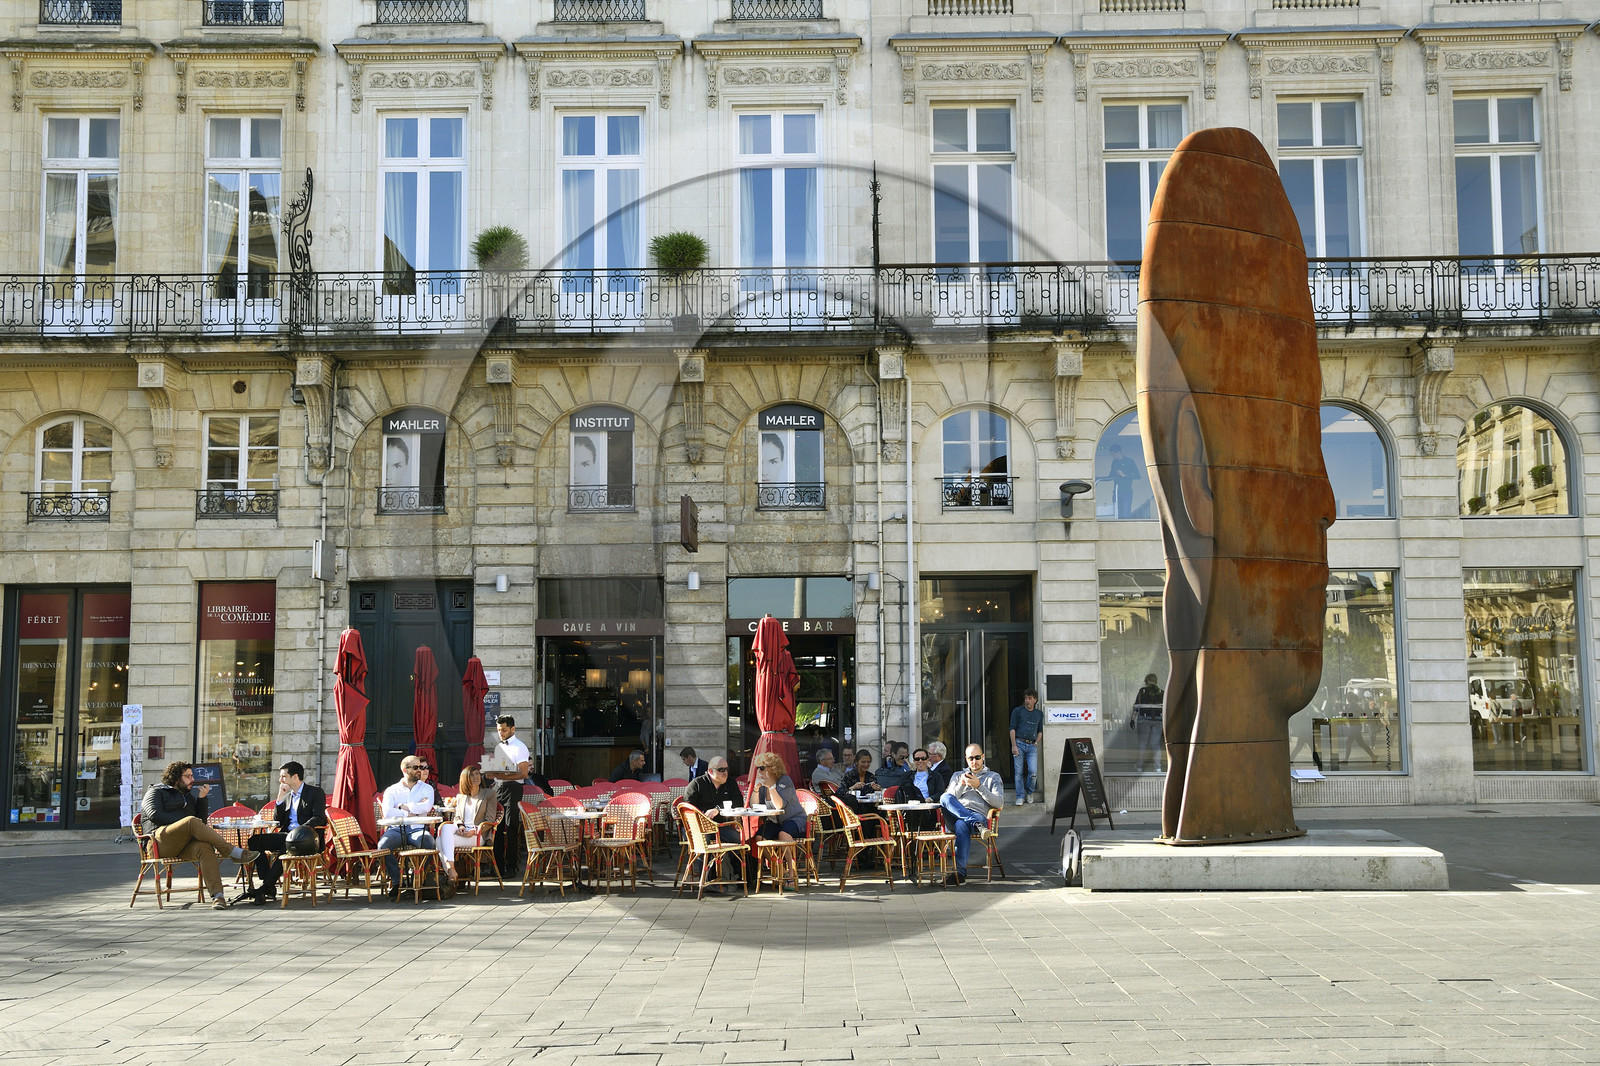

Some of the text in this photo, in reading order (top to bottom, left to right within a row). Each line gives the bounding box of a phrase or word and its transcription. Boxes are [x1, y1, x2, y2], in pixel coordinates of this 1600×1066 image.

[389, 420, 440, 430] MAHLER
[575, 417, 630, 428] INSTITUT
[765, 415, 816, 426] MAHLER
[207, 605, 249, 613] LIBRAIRIE
[27, 615, 61, 624] FÉRET
[220, 611, 271, 622] COMÉDIE
[563, 623, 636, 632] CAVE A VIN
[748, 621, 834, 632] CE BAR
[210, 676, 264, 684] Gastronomie
[228, 687, 247, 696] Vins
[210, 697, 264, 708] Régionalisme
